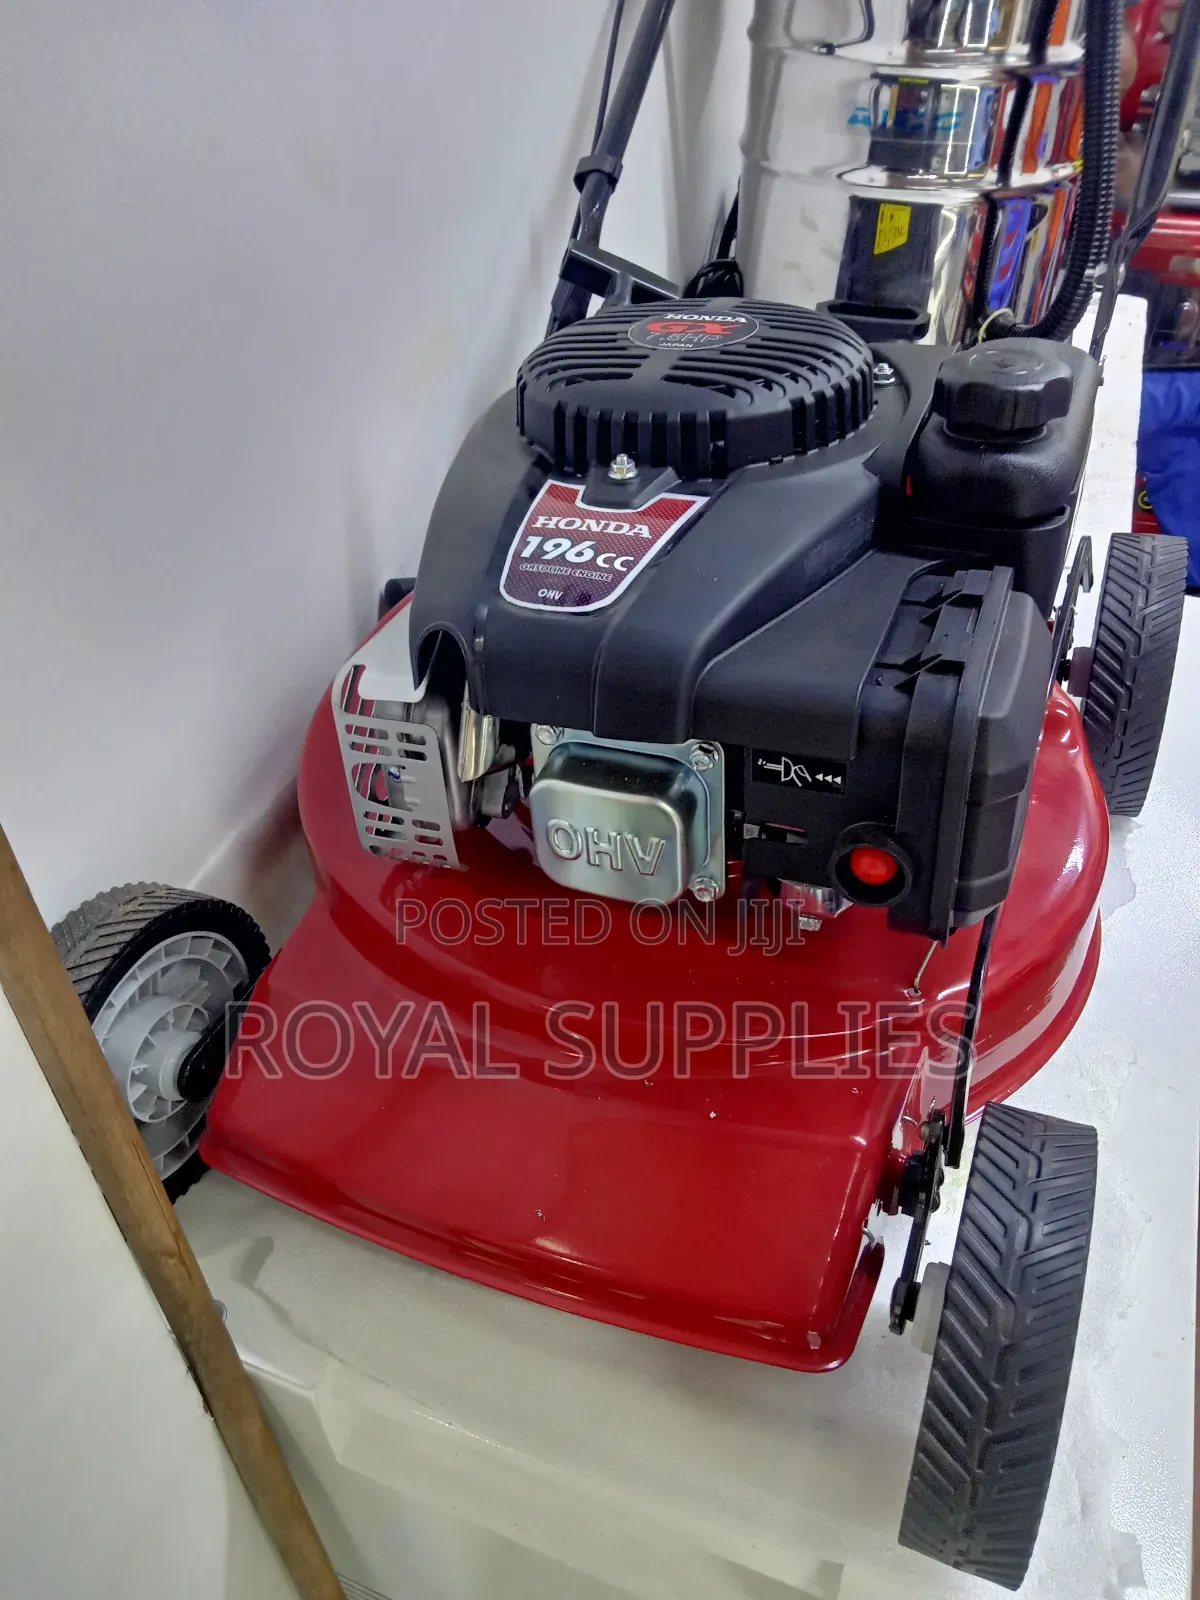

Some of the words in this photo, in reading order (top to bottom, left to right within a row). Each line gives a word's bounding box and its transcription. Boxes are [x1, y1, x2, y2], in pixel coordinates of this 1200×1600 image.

[664, 313, 747, 323] HONDA
[646, 321, 744, 336] GX
[532, 515, 652, 539] HONDA
[519, 563, 571, 576] GASOLINE
[571, 568, 613, 582] ENGINE
[537, 588, 564, 600] OHV
[546, 817, 667, 876] OHV
